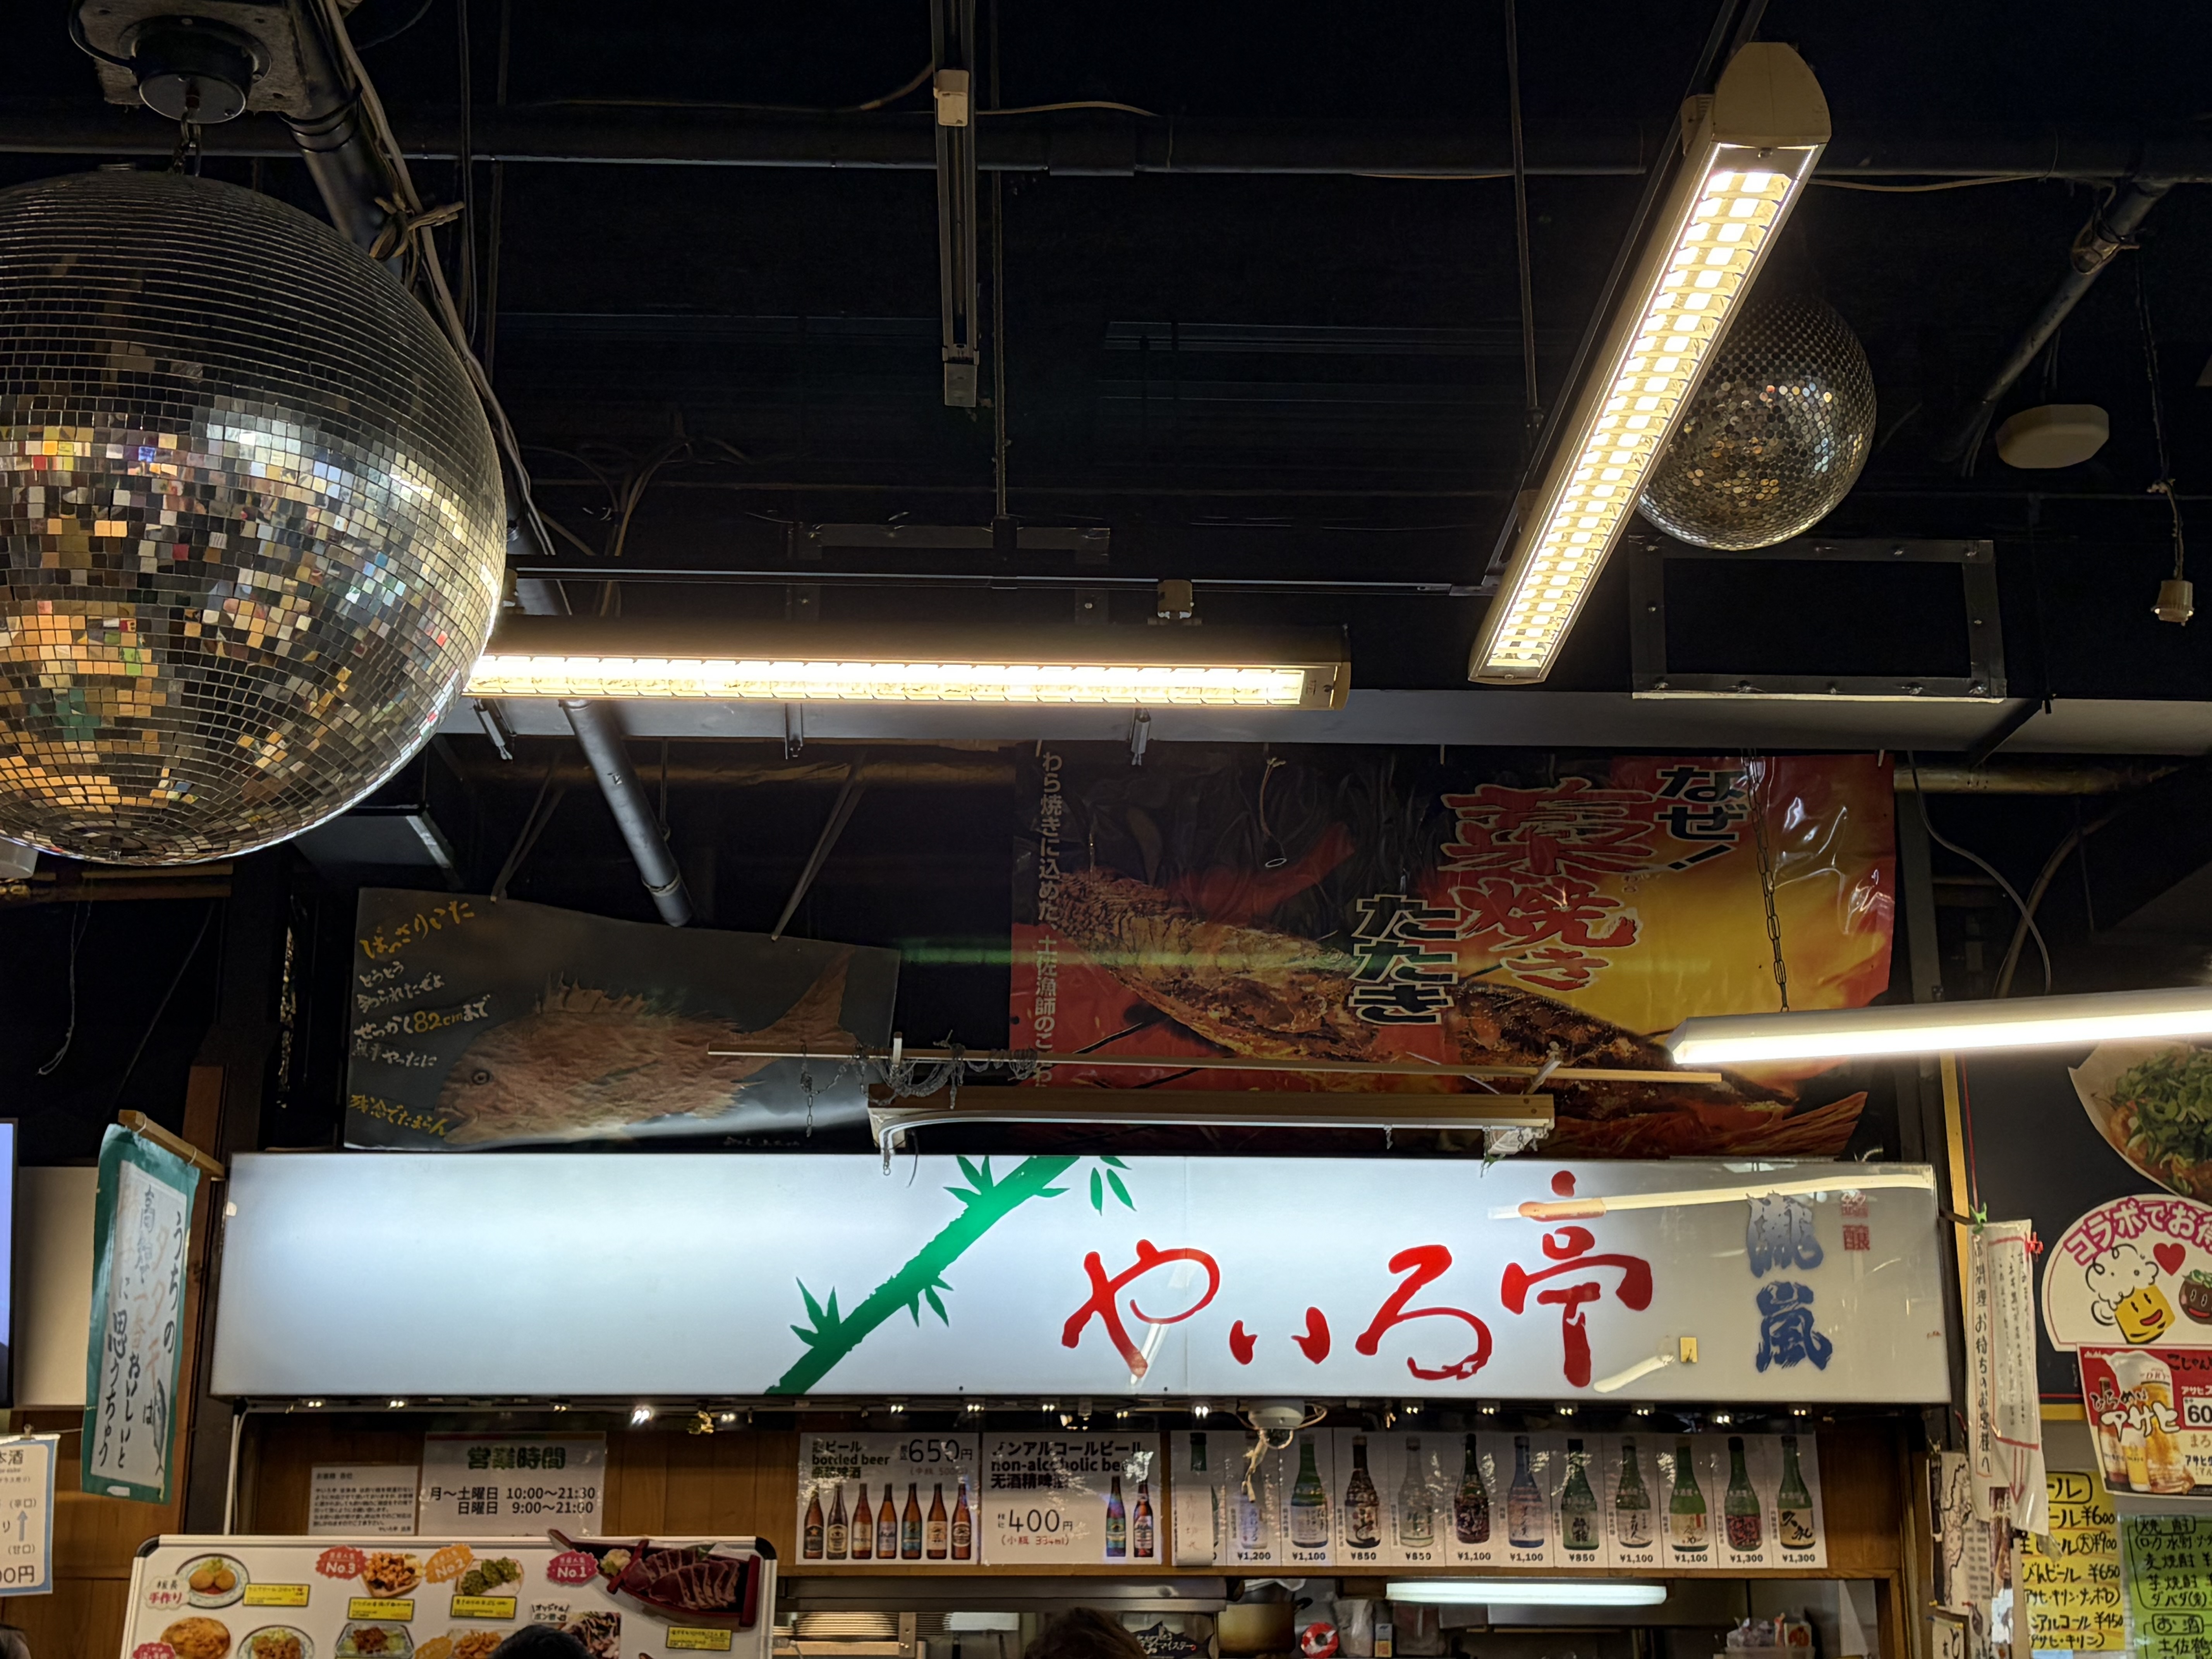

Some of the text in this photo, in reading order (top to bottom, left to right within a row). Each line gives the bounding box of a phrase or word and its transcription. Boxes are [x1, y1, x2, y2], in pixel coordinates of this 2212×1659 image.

[1351, 894, 1462, 1025] たたき
[359, 961, 404, 988] とうとう
[1033, 935, 1058, 1087] 土佐漁師のこわ
[350, 1094, 448, 1136] 残念でたまらん
[163, 1211, 183, 1354] うちの
[1061, 1170, 1654, 1388] やいろ亭
[2101, 1400, 2181, 1442] アサヒ
[467, 1446, 566, 1470] 営業時間
[861, 1454, 890, 1465] beer
[991, 1457, 1098, 1472] non-alcolic
[2047, 1478, 2082, 1499] ール
[458, 1501, 498, 1515] 日曜日
[2048, 1505, 2115, 1529] ール ¥600
[2093, 1530, 2117, 1554] ¥900
[325, 1562, 356, 1573] No.3
[557, 1566, 587, 1578] No.1
[2088, 1563, 2120, 1584] ¥650
[149, 1592, 182, 1604] 手作り
[2031, 1611, 2124, 1633] ンアルコール ¥450
